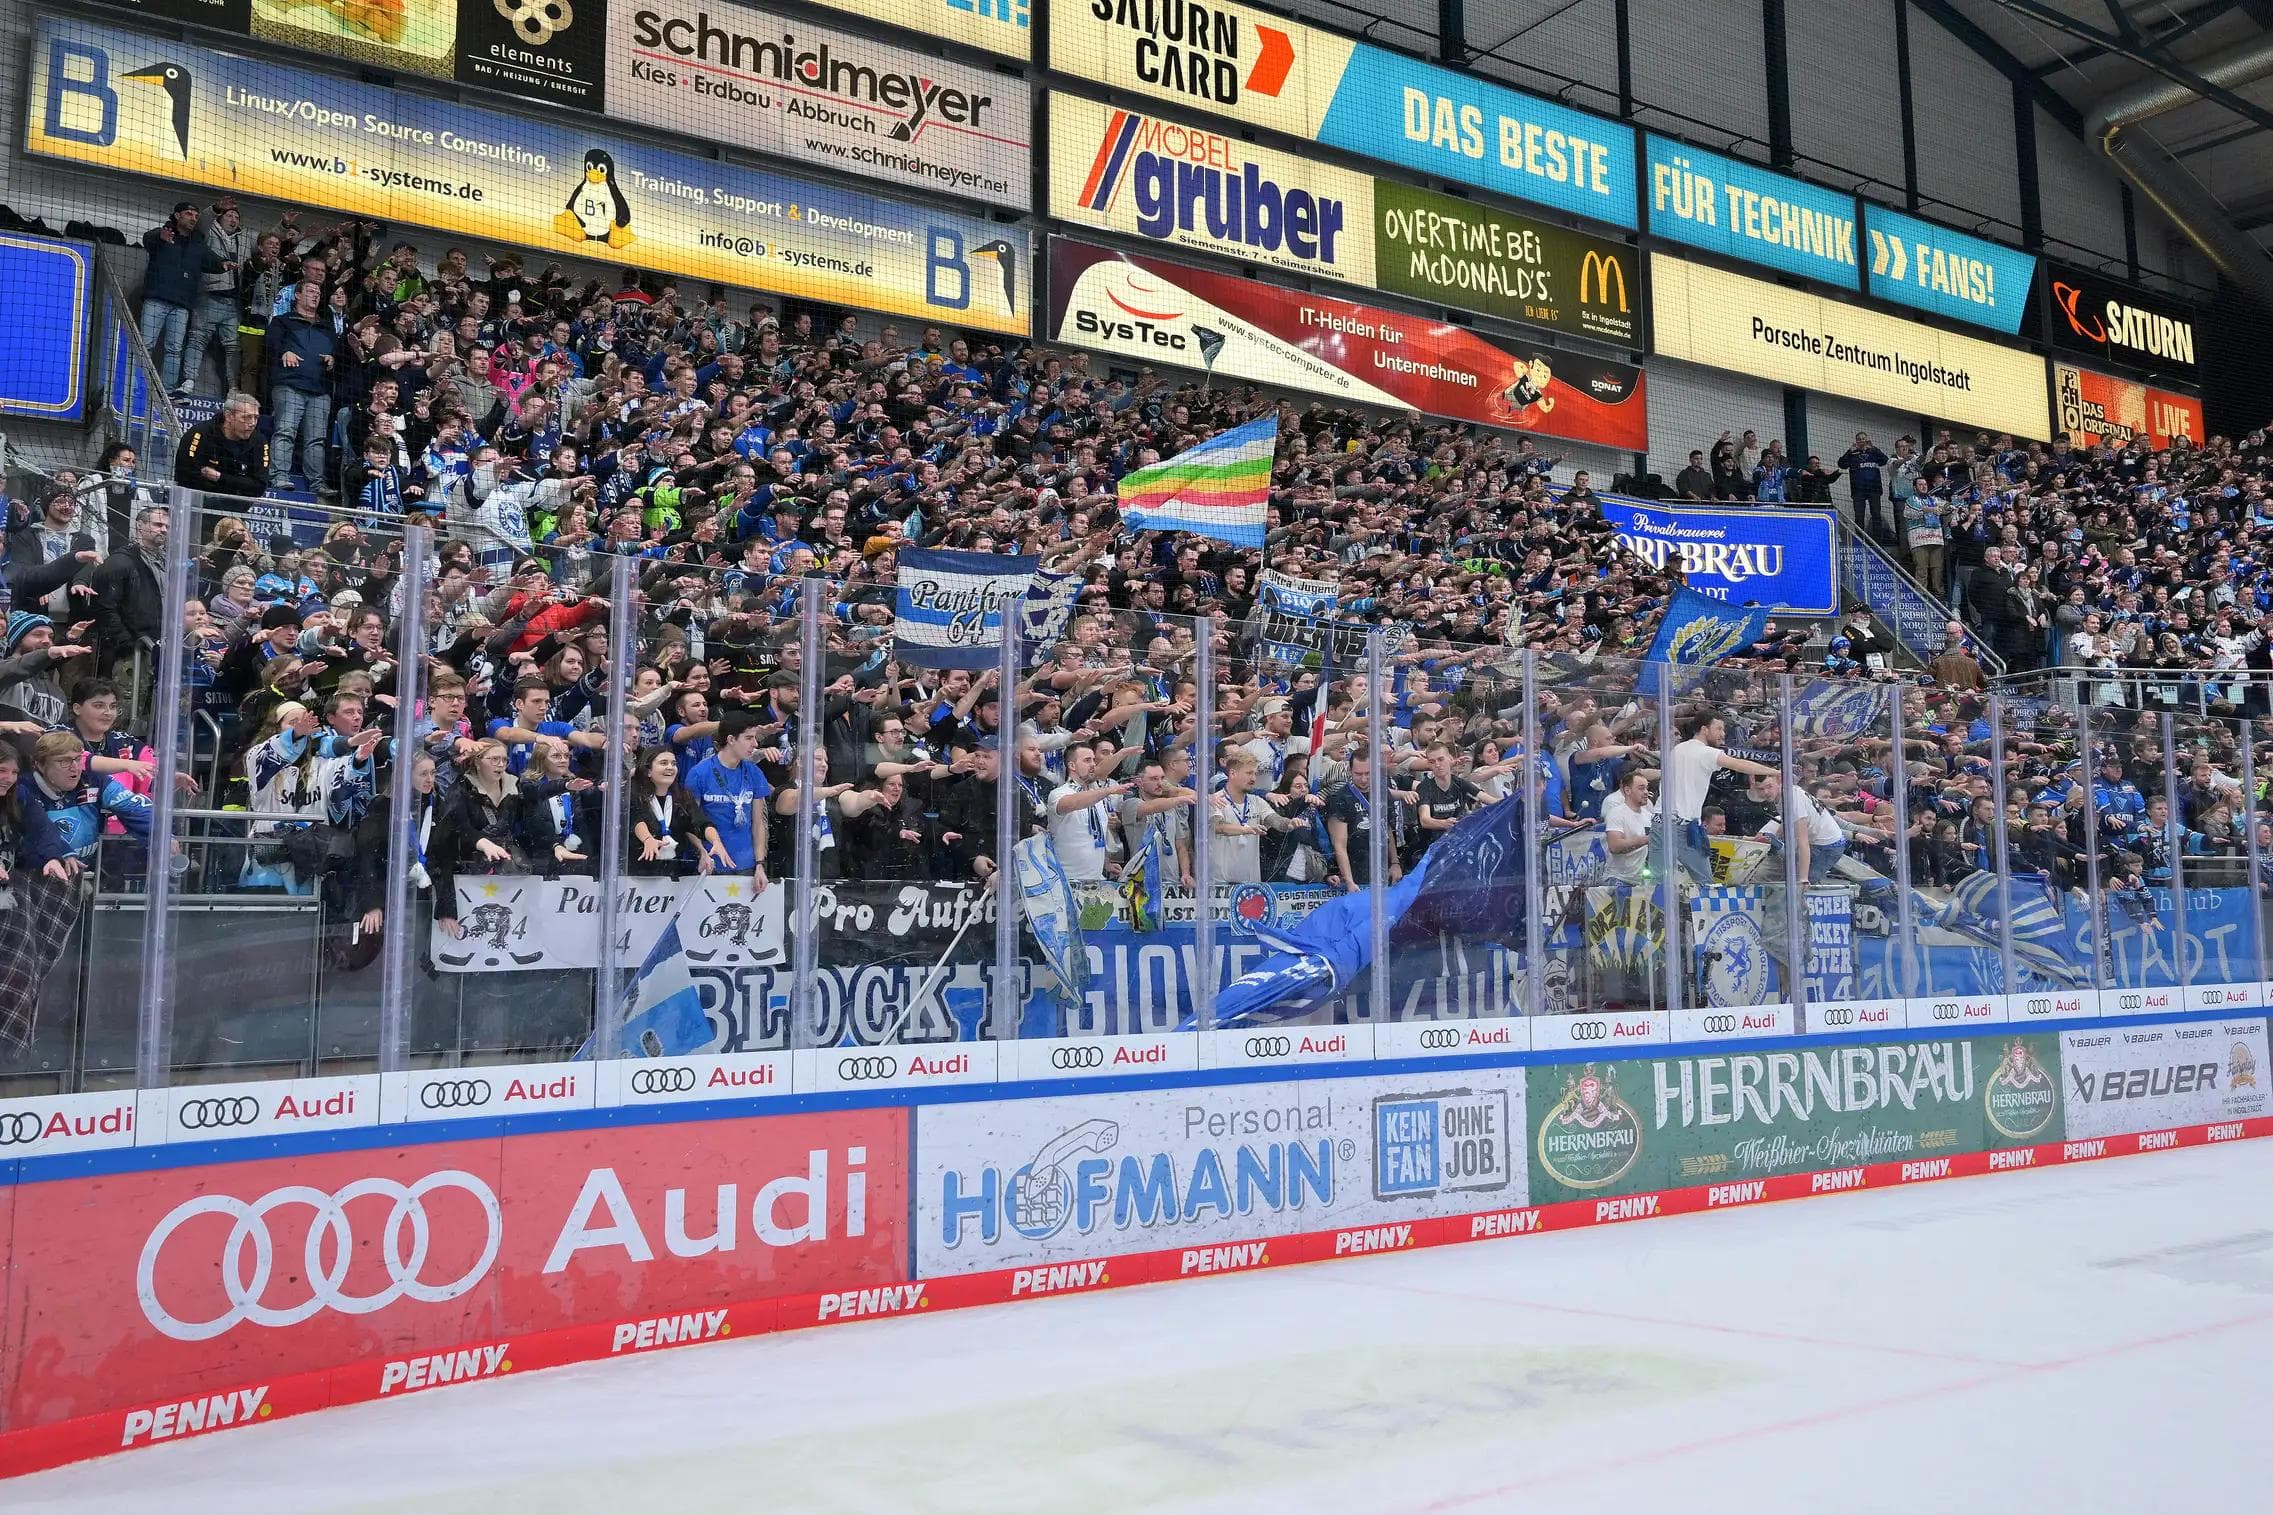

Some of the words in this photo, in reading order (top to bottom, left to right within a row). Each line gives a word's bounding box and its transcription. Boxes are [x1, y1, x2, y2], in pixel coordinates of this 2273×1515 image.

[490, 43, 573, 74] elements
[632, 10, 993, 132] schmidmeyer
[1135, 37, 1239, 105] CARD
[474, 63, 492, 74] BAD
[503, 70, 541, 86] HEIZUNG
[550, 81, 587, 96] ENERGIE
[631, 59, 677, 88] Kies
[693, 76, 771, 110] Erdbau
[786, 97, 876, 135] Abbruch
[226, 85, 357, 130] Linux/Open
[362, 114, 435, 147] Source
[439, 130, 552, 174] Consulting,
[1139, 112, 1239, 173] MÖBEL
[1402, 86, 1485, 160] DAS
[1499, 115, 1611, 196] BESTE
[805, 137, 1009, 195] www.schmidmeyer.net
[630, 169, 710, 206] Training,
[712, 186, 783, 220] Support
[786, 203, 802, 222] &
[807, 207, 915, 246] Development
[1133, 151, 1345, 265] gruber
[1653, 156, 1717, 228] FÜR
[1723, 183, 1857, 267] TECHNIK
[1178, 234, 1248, 260] Siemensstr.
[1251, 251, 1260, 260] 7
[1270, 255, 1346, 280] Gaimersheim
[1916, 243, 1996, 308] FANS!
[1075, 309, 1187, 352] SysTec
[1298, 306, 1376, 342] IT-Helden
[1378, 324, 1404, 346] für
[1591, 313, 1599, 322] in
[1599, 314, 1632, 331] Ingolstadt
[2106, 299, 2195, 365] SATURN
[1373, 350, 1478, 389] Unternehmen
[1752, 316, 1822, 356] Porsche
[1824, 334, 1893, 373] Zentrum
[1895, 351, 1972, 394] Ingolstadt
[1591, 379, 1623, 393] DONAT
[2082, 401, 2105, 419] DAS
[2154, 400, 2192, 444] LIVE
[1632, 512, 1727, 539] Privatbrauerei
[1297, 580, 1339, 595] Jugend
[947, 609, 986, 646] 64
[558, 885, 676, 917] Panther
[790, 884, 875, 938] Pro
[1279, 891, 1290, 901] ES
[511, 915, 528, 938] 4
[698, 914, 713, 940] 6
[749, 914, 764, 937] 4
[694, 964, 956, 1053] BLOCK
[1963, 1001, 1992, 1017] Audi
[2055, 998, 2081, 1012] Audi
[2145, 994, 2169, 1008] Audi
[2225, 990, 2248, 1002] Audi
[1613, 1020, 1651, 1038] Audi
[1741, 1013, 1776, 1030] Audi
[1858, 1008, 1890, 1024] Audi
[1298, 1035, 1347, 1054] Audi
[1467, 1027, 1511, 1046] Audi
[907, 1054, 969, 1078] Audi
[1112, 1044, 1167, 1065] Audi
[504, 1076, 577, 1102] Audi
[708, 1063, 775, 1088] Audi
[1652, 1040, 1975, 1130] HERRNBRÄU
[273, 1090, 356, 1120] Audi
[1184, 1096, 1334, 1141] Personal
[42, 1106, 135, 1138] Audi
[1384, 1109, 1431, 1147] KEIN
[1444, 1102, 1496, 1139] OHNE
[1548, 1128, 1634, 1153] HERRNBRÄU
[1385, 1147, 1433, 1185] FAN
[1444, 1138, 1502, 1178] JOB.
[541, 1145, 868, 1276] Audi
